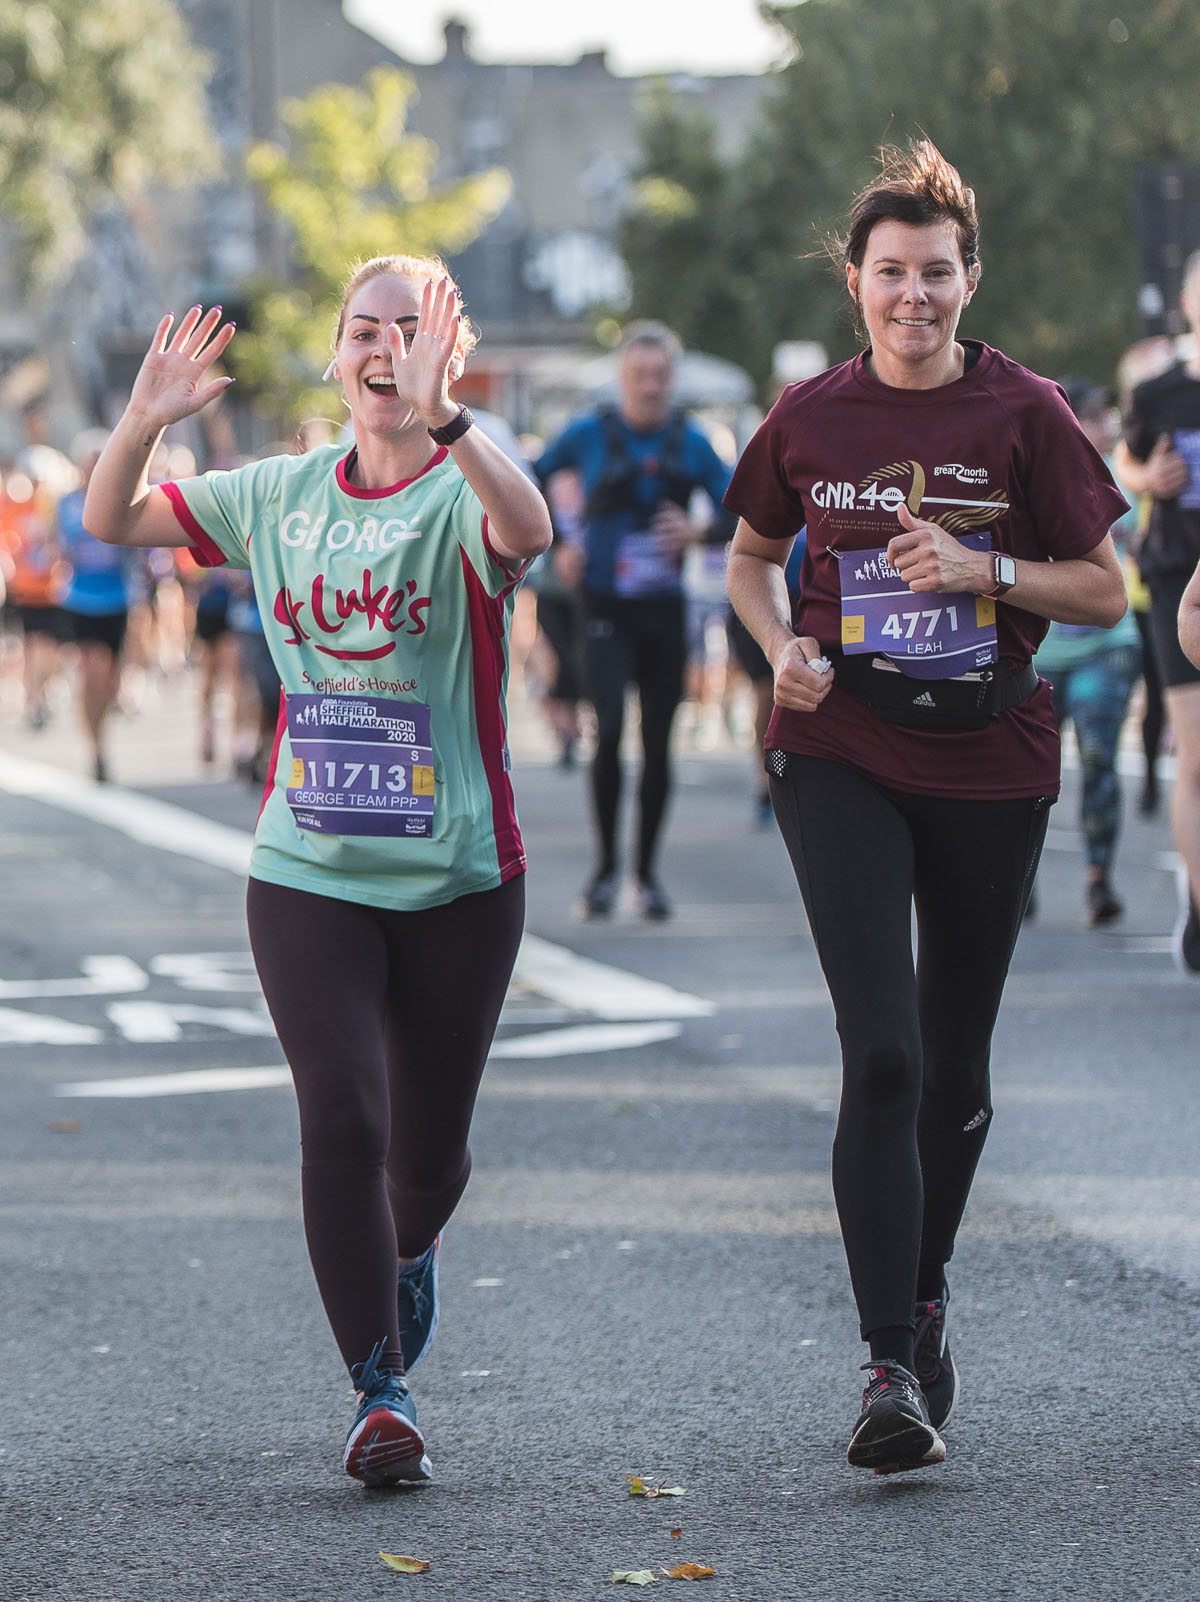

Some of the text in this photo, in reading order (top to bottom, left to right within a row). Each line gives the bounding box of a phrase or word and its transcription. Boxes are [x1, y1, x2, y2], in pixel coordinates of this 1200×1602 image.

[934, 466, 988, 477] great north
[881, 568, 902, 578] HAL
[311, 568, 432, 635] Luke's
[881, 606, 958, 639] 4771
[907, 641, 942, 654] LEAH
[367, 677, 417, 695] Hospice
[322, 705, 375, 717] SHEFFIELD
[320, 716, 414, 731] HALF MARATHON
[387, 730, 416, 742] 2020
[411, 750, 419, 761] S
[308, 760, 406, 792] 11713
[295, 791, 419, 808] GEORGE TEAM PPP
